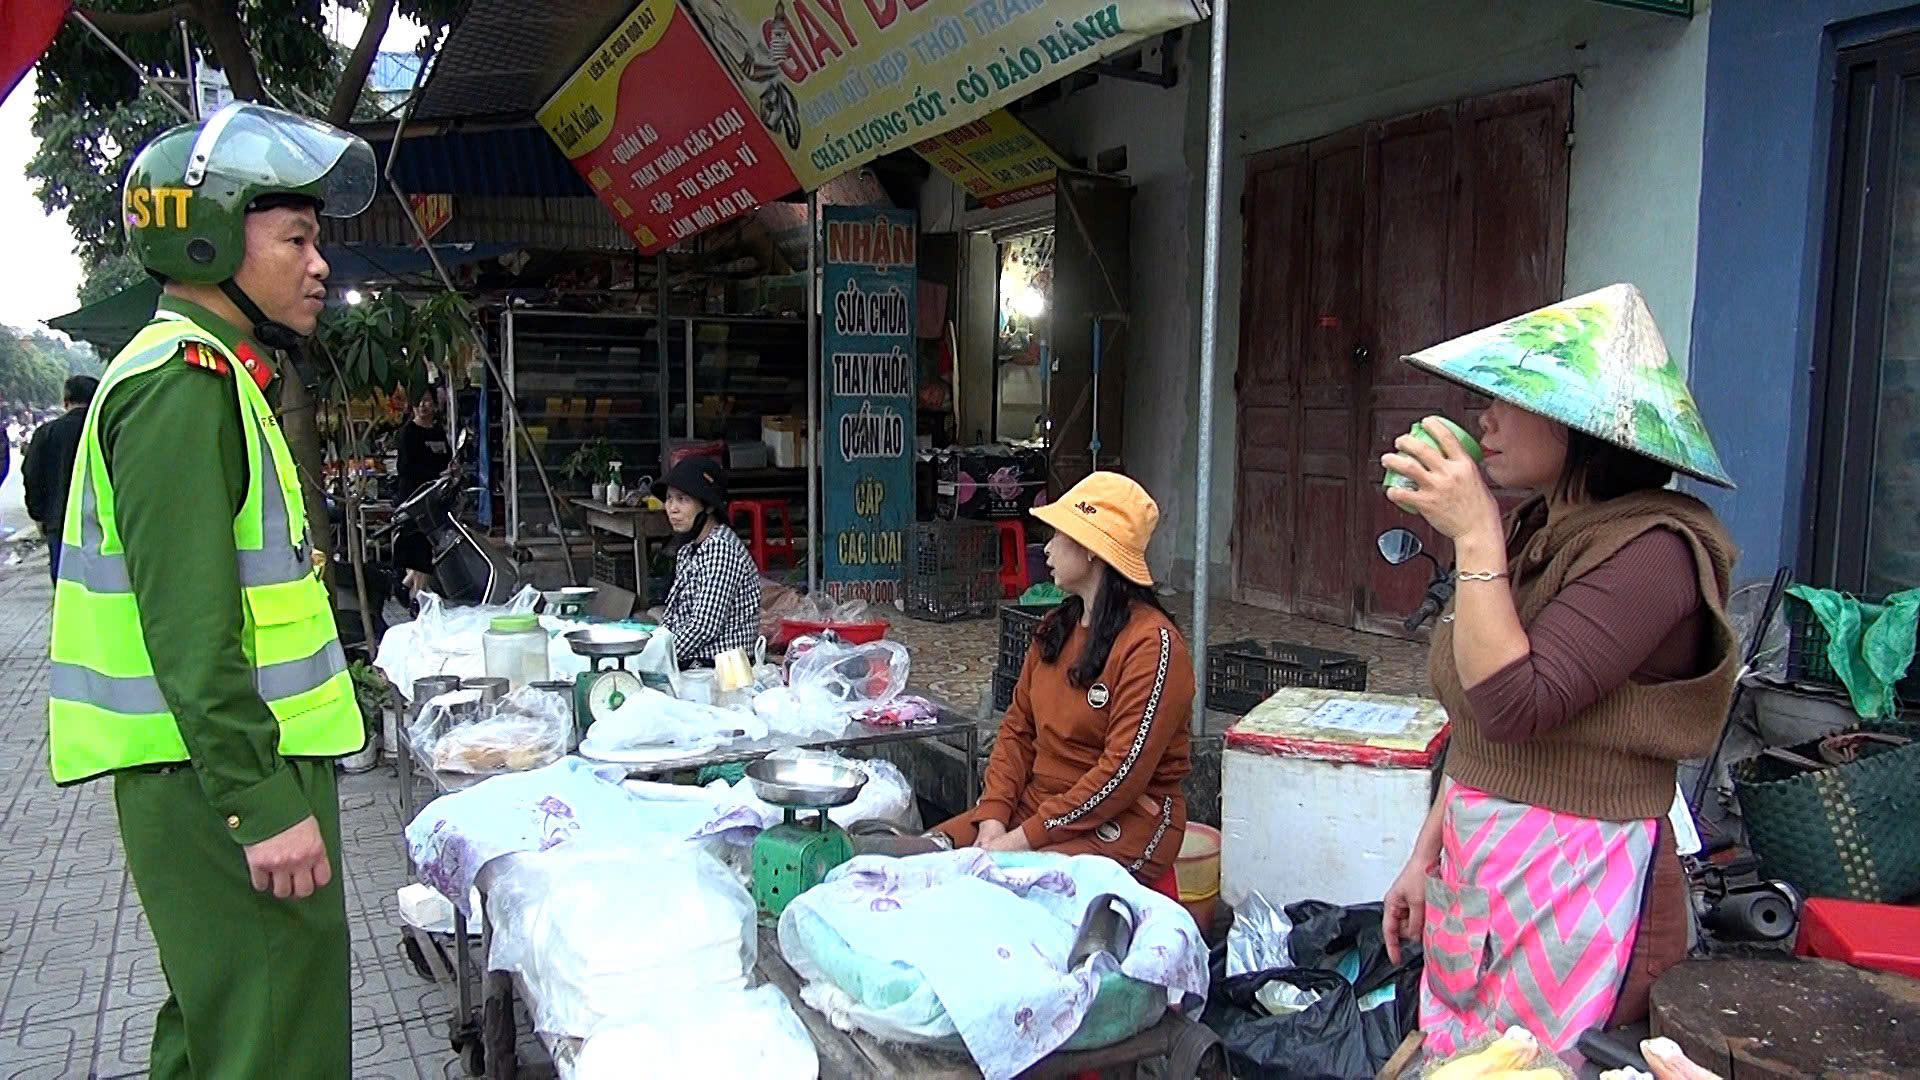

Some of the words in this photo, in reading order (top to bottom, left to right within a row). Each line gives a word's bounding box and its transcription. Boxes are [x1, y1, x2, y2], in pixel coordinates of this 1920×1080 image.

[810, 133, 851, 171] CHẤT
[848, 110, 908, 154] LƯỢNG
[904, 85, 947, 126] TỐT
[956, 65, 989, 104] CÓ
[986, 47, 1042, 90] BẢO
[1038, 3, 1125, 64] HÀNH
[867, 48, 911, 90] HỢP
[631, 163, 660, 189] THAY
[653, 145, 691, 175] KHÓA
[683, 129, 714, 156] CÁC
[707, 107, 746, 141] LOẠI
[636, 123, 659, 146] ÁO
[676, 176, 702, 200] TÚI
[695, 159, 735, 190] SÁCH
[735, 140, 759, 167] VÍ
[713, 197, 737, 218] ÁO
[731, 187, 758, 210] DA
[826, 215, 916, 276] NHẬN
[835, 278, 867, 336] SỬA
[868, 286, 909, 336] CHỮA
[832, 353, 869, 396] THAY
[882, 406, 905, 458] ÁO
[854, 476, 885, 521] CẶP
[838, 526, 868, 566] CÁC
[871, 531, 903, 571] LOẠI
